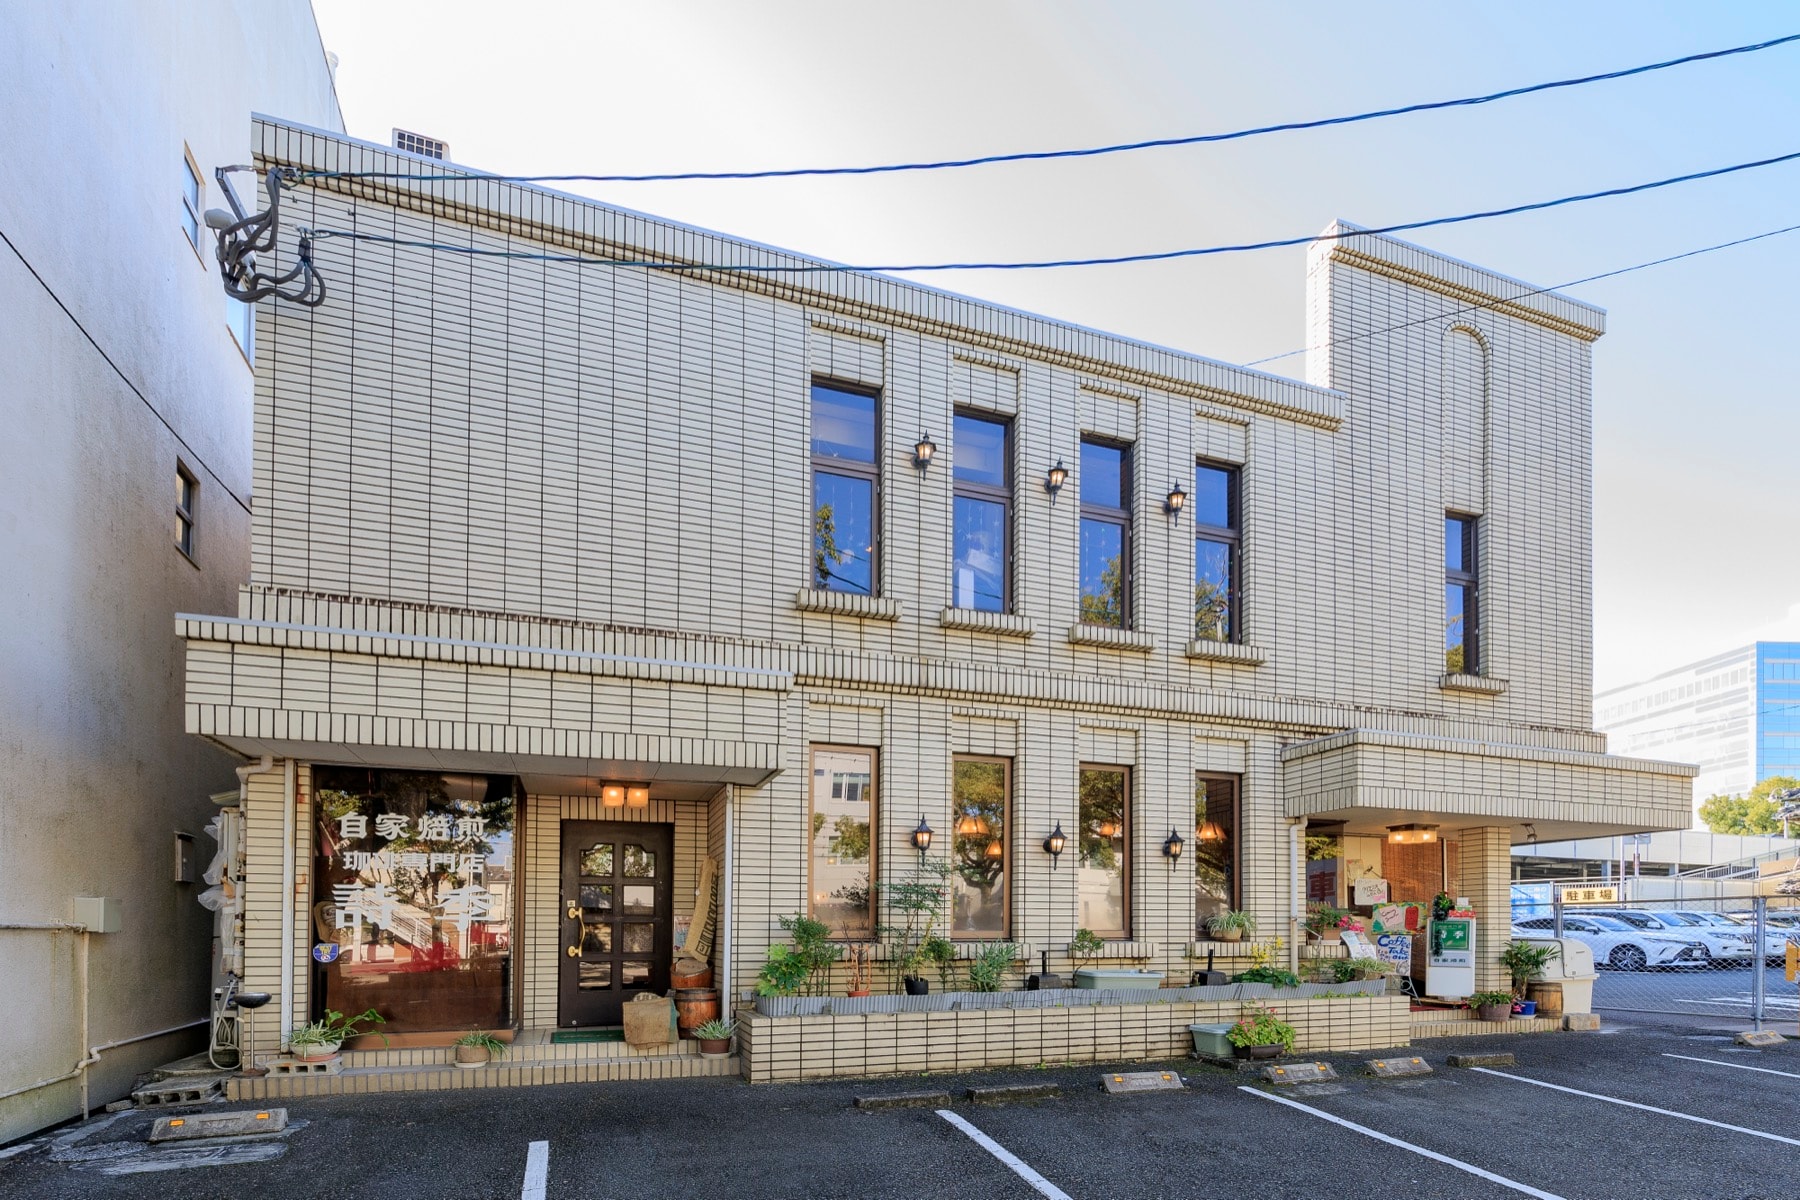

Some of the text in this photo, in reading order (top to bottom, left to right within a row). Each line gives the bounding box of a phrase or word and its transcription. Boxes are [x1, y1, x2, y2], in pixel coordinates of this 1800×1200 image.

[335, 812, 490, 843] 自家焙煎
[1566, 889, 1612, 901] 駐車場
[332, 882, 495, 932] 詩季
[1377, 934, 1411, 948] Coffee
[1388, 946, 1409, 956] Take
